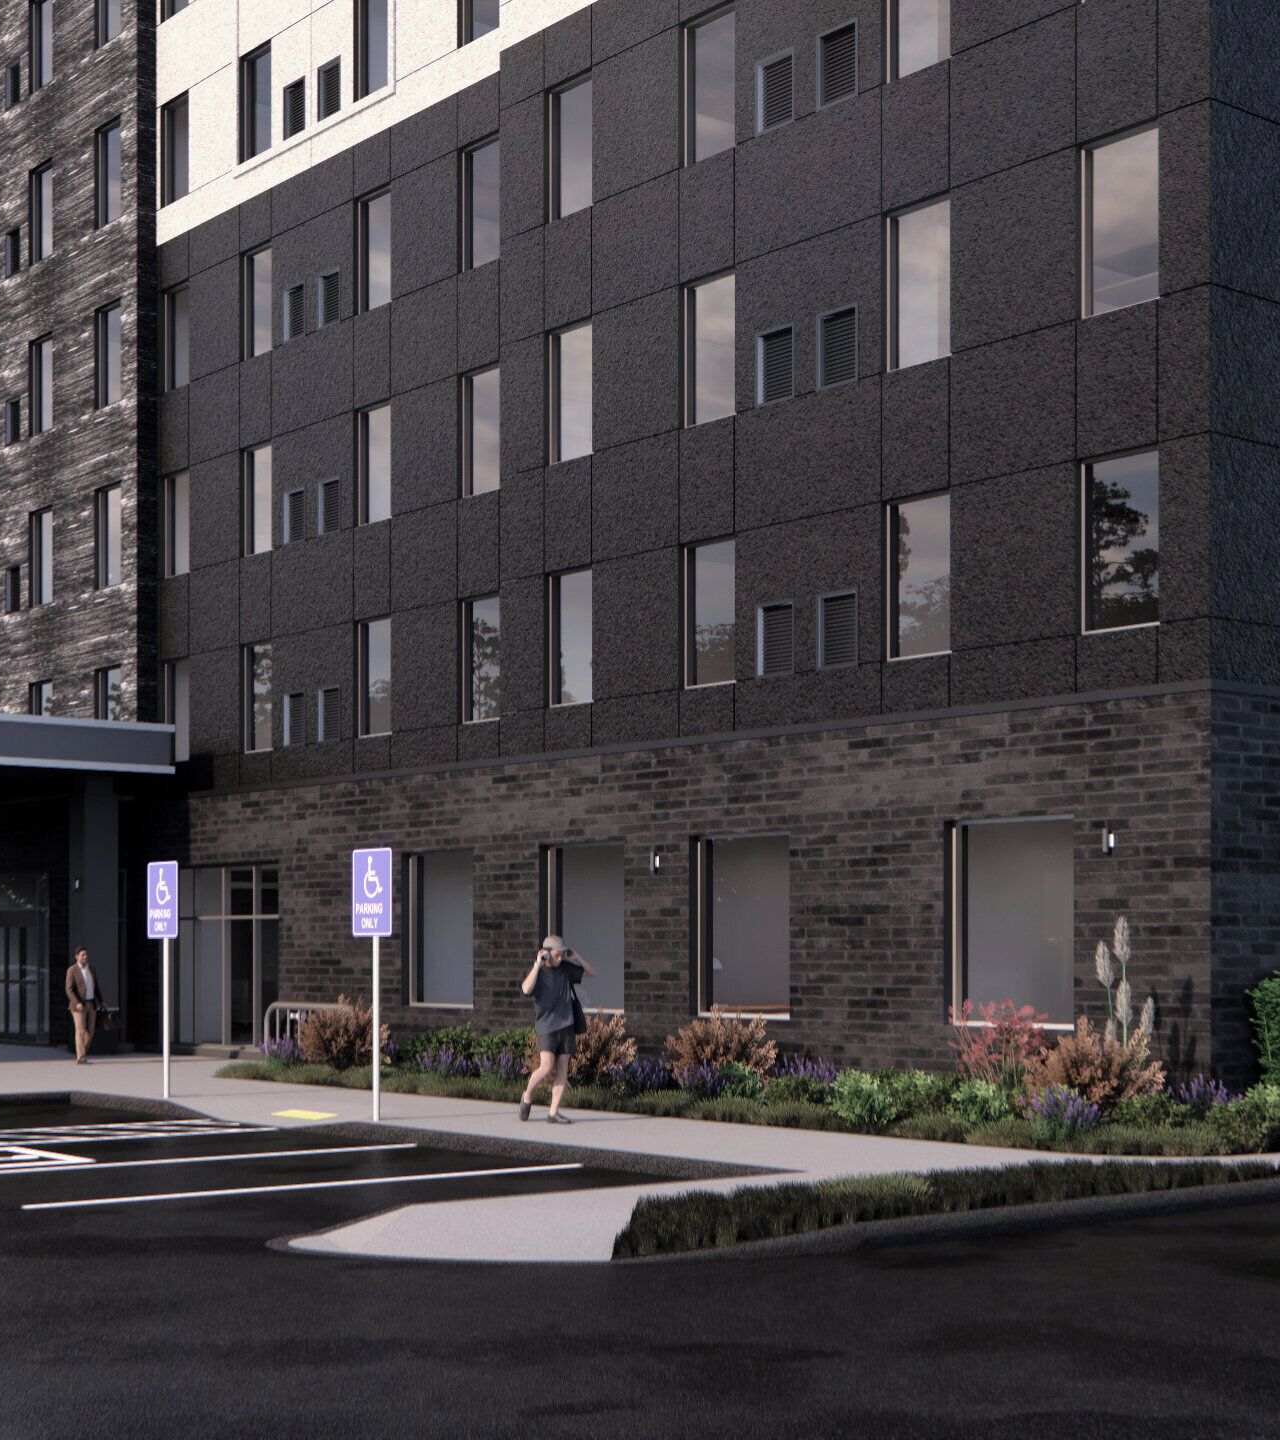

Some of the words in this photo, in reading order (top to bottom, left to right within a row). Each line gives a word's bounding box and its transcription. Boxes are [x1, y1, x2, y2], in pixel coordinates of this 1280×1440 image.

[149, 908, 171, 919] PARKING
[355, 903, 383, 915] PARKING
[154, 921, 167, 932] ONLY
[361, 917, 378, 929] ONLY
